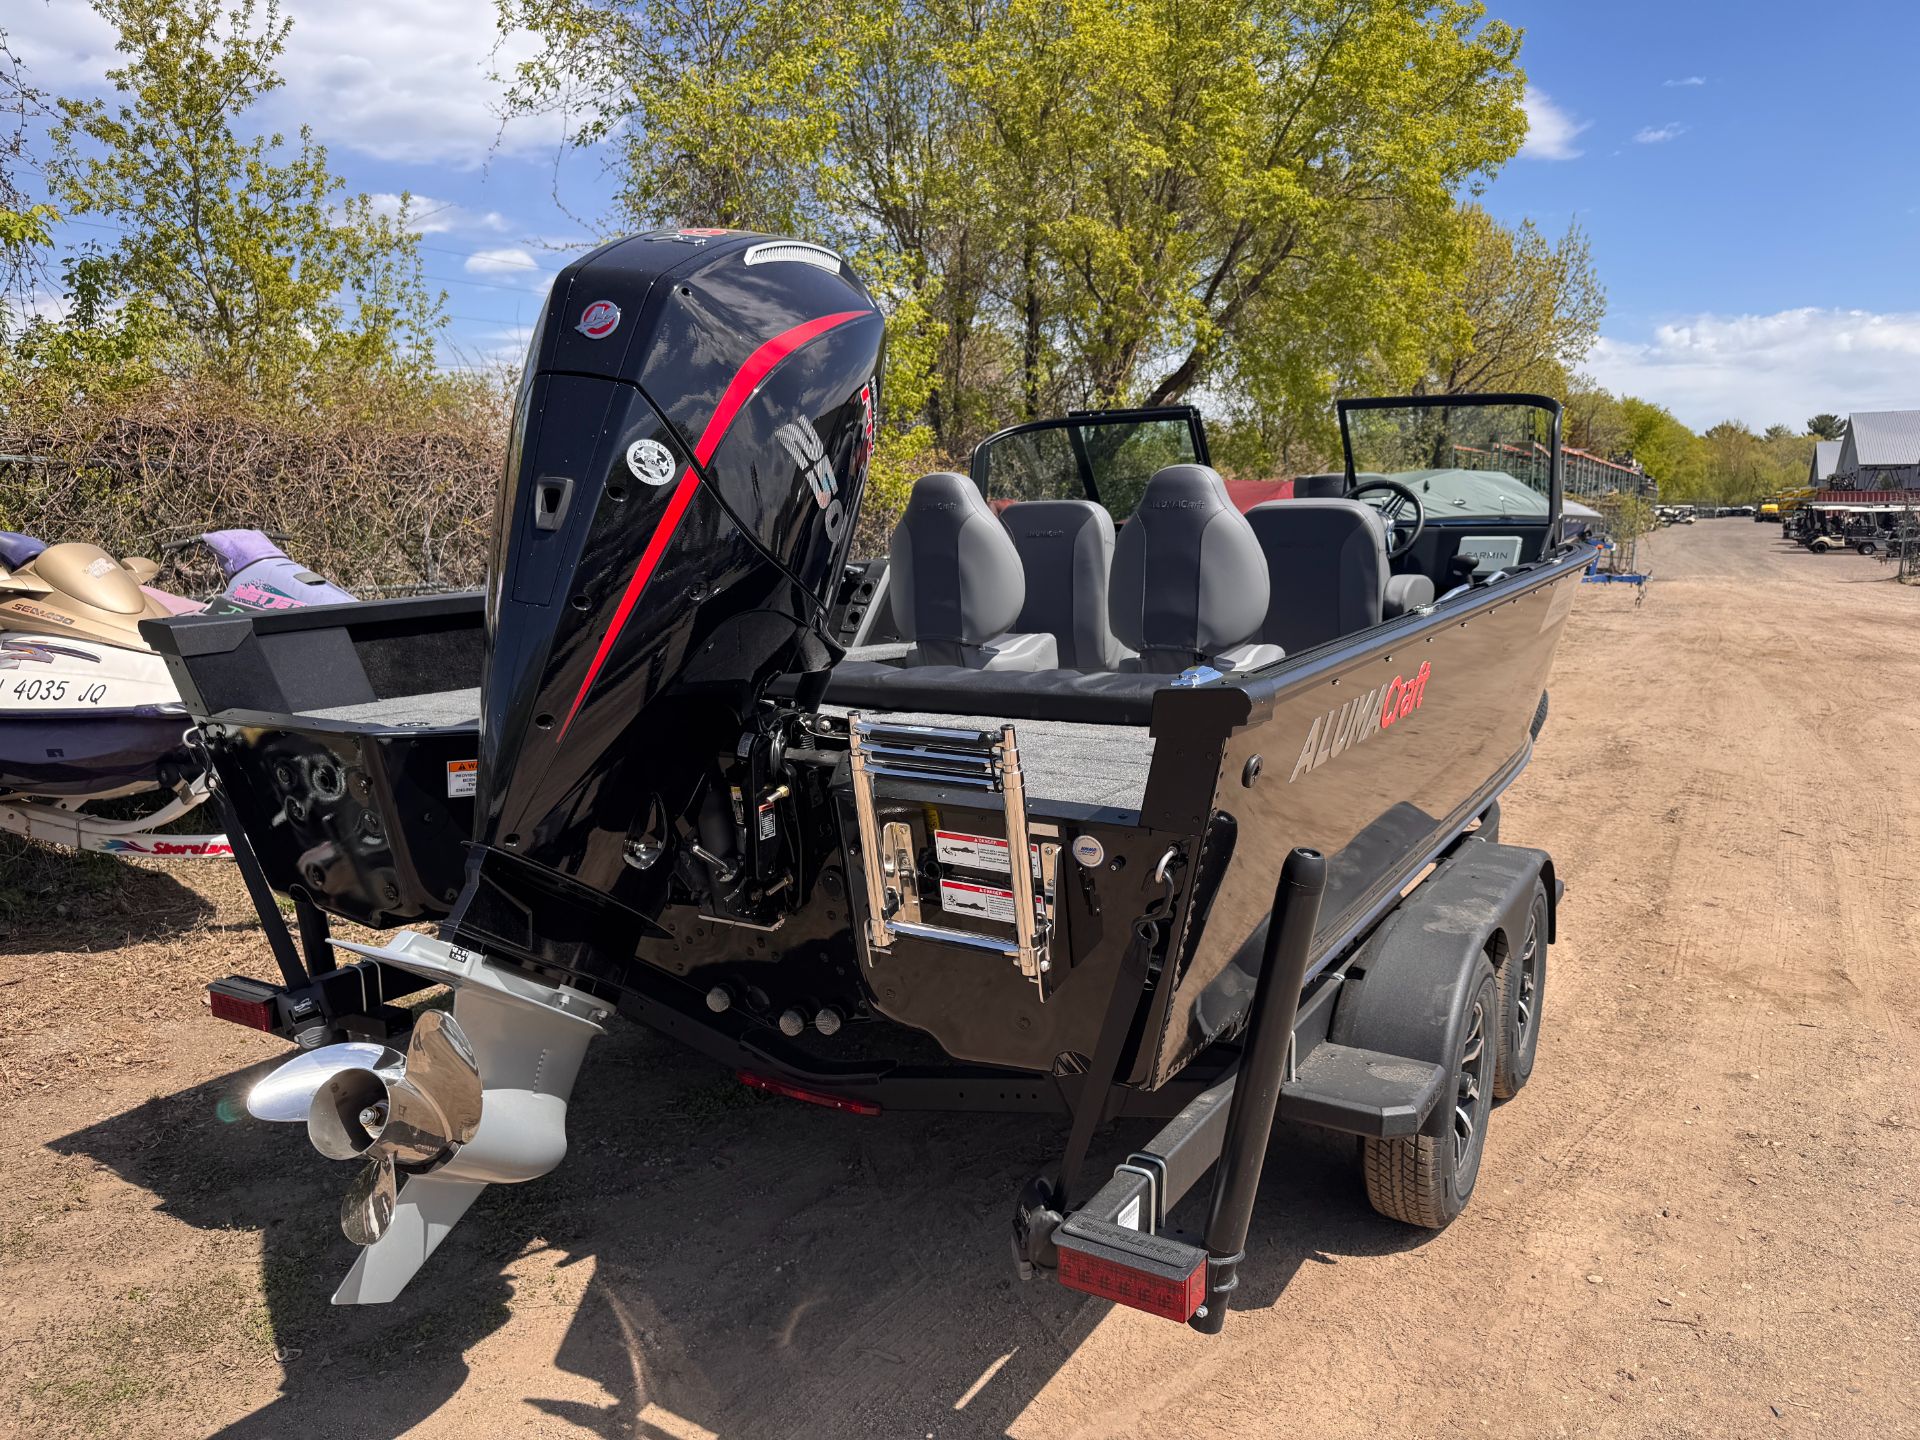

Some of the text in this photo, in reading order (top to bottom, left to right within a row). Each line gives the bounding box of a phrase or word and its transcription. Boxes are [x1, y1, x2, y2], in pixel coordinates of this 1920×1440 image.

[775, 414, 844, 543] 250
[1465, 551, 1508, 560] GARMIN
[13, 679, 70, 701] 4035
[78, 683, 107, 704] JQ
[151, 842, 233, 855] ShoreLan
